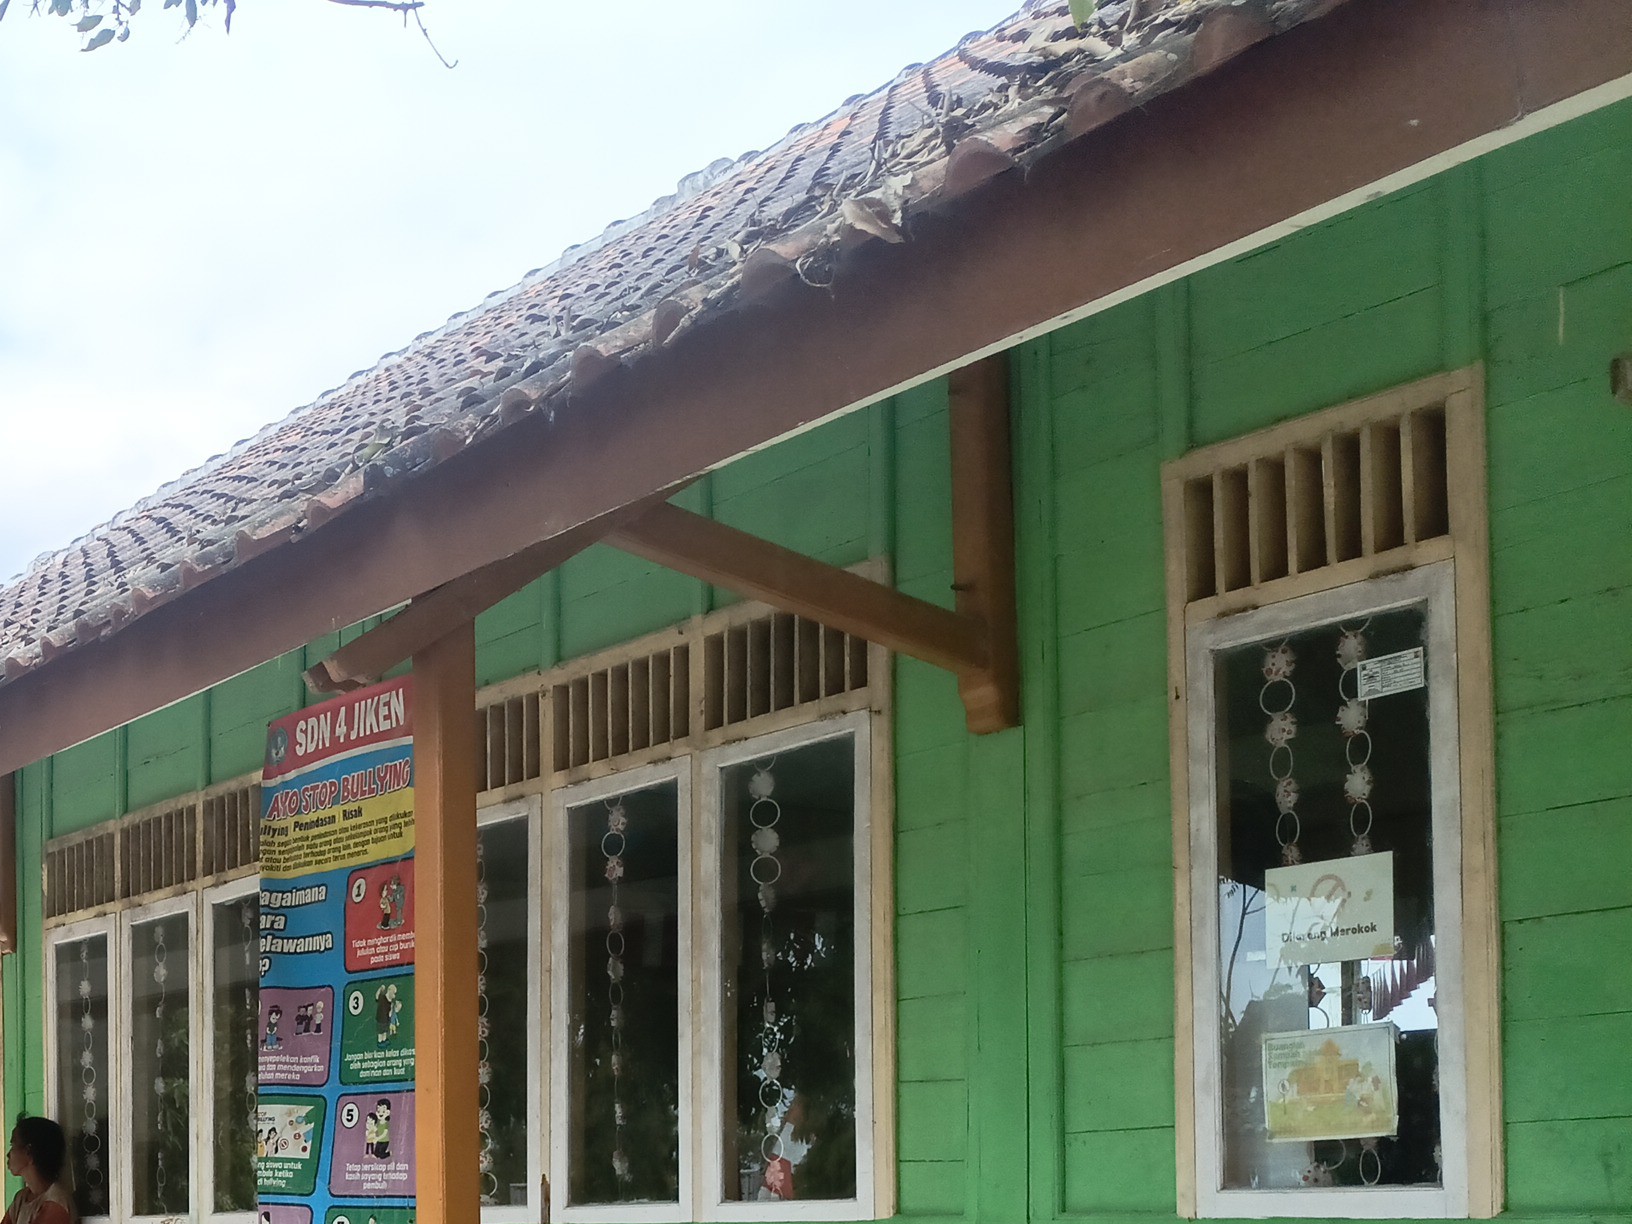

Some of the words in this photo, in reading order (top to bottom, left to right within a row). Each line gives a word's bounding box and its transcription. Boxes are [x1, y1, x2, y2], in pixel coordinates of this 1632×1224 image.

[295, 711, 331, 757] SDN
[335, 706, 347, 743] 4
[350, 688, 405, 741] JIKEN
[266, 789, 300, 821] AYO
[301, 779, 339, 814] STOP
[340, 757, 411, 804] BULLYING
[260, 825, 288, 838] ullying
[293, 815, 336, 832] Penindasan
[342, 806, 363, 821] Risak
[260, 885, 327, 908] agaimana
[355, 883, 362, 898] 1
[260, 914, 286, 930] ara
[1330, 922, 1378, 937] Merokok
[260, 932, 333, 953] elawannya
[352, 997, 360, 1010] 3
[346, 1109, 354, 1123] 5
